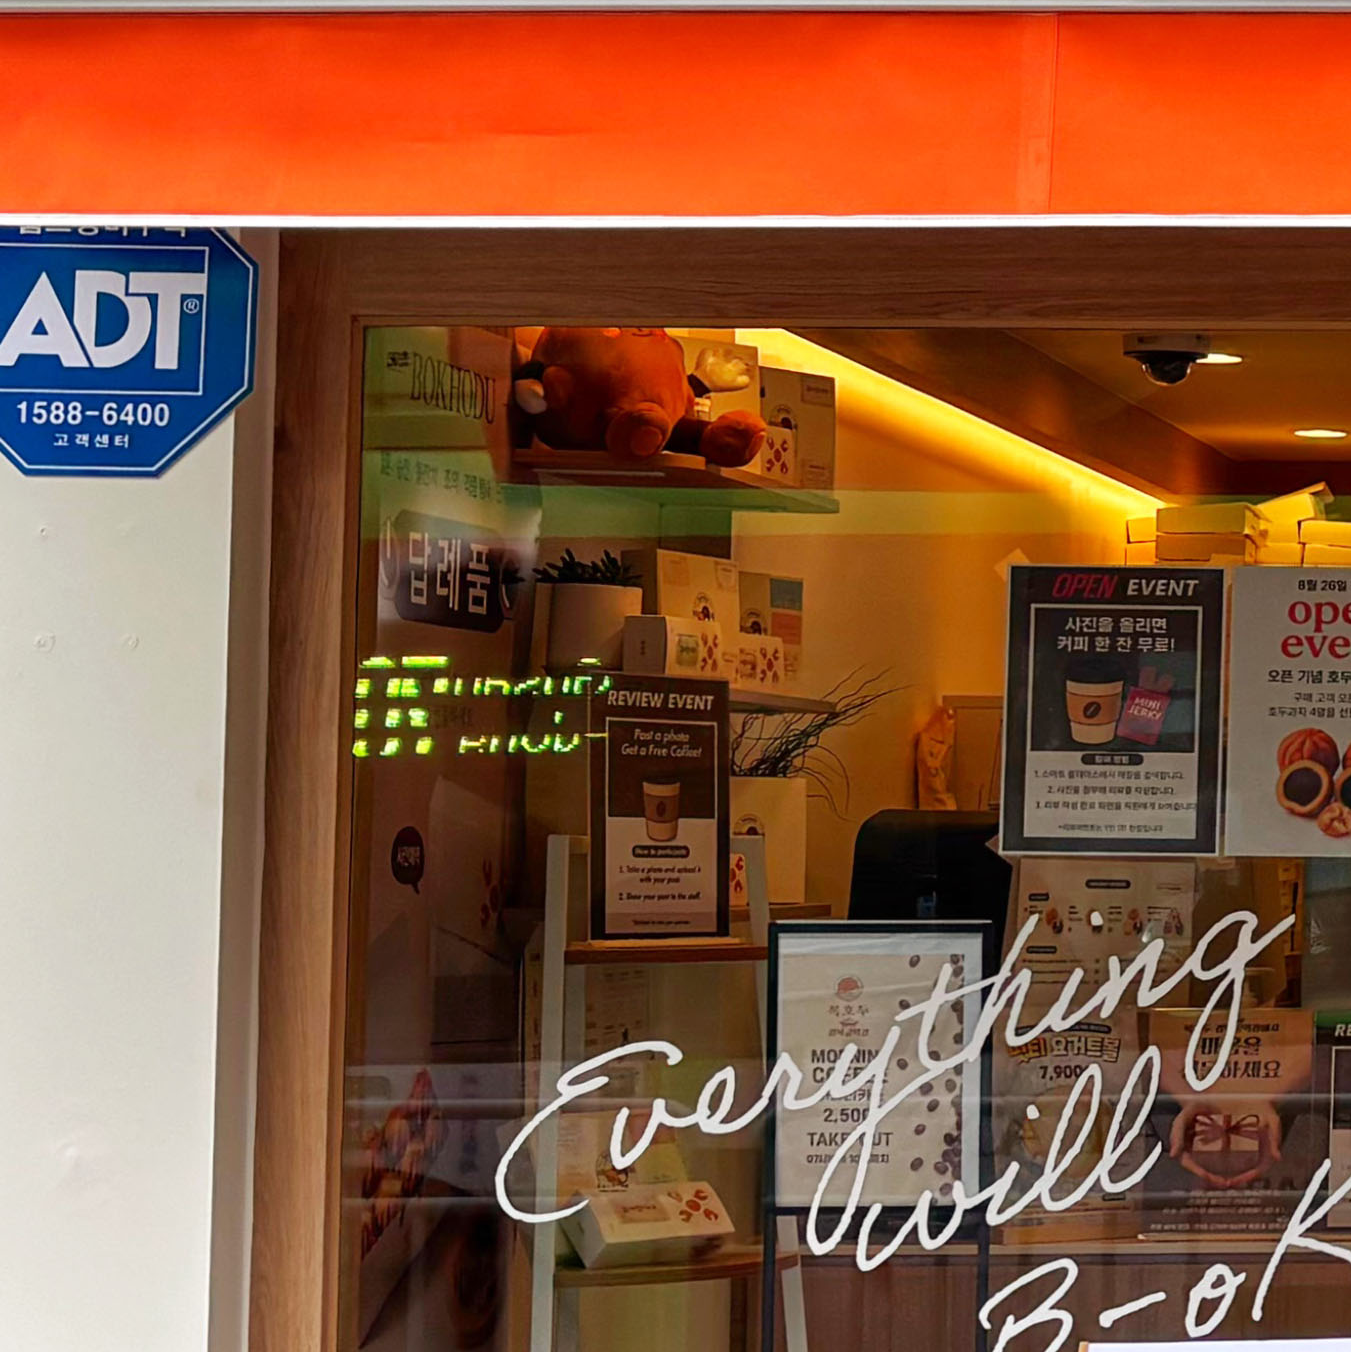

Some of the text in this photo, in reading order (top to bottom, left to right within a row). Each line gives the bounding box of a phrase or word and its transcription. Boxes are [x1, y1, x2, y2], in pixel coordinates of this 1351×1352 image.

[0, 270, 207, 369] ADT
[411, 352, 496, 424] BOKHODU
[17, 401, 170, 427] 1588-6400
[53, 433, 130, 449] 고객센터
[408, 531, 490, 615] 답례품
[1052, 573, 1200, 599] OPEN EVENT
[1297, 579, 1317, 592] 8월
[1321, 580, 1347, 592] 26일
[1065, 617, 1168, 634] 사진을 올리면
[1057, 636, 1176, 653] 커피 한 잔 무료!
[1268, 669, 1293, 683] 오픈
[1298, 670, 1323, 683] 기념
[607, 690, 715, 710] REVIEW EVENT
[811, 1049, 882, 1063] MONIN
[495, 911, 1296, 1256] Everything
[856, 1046, 1163, 1272] will
